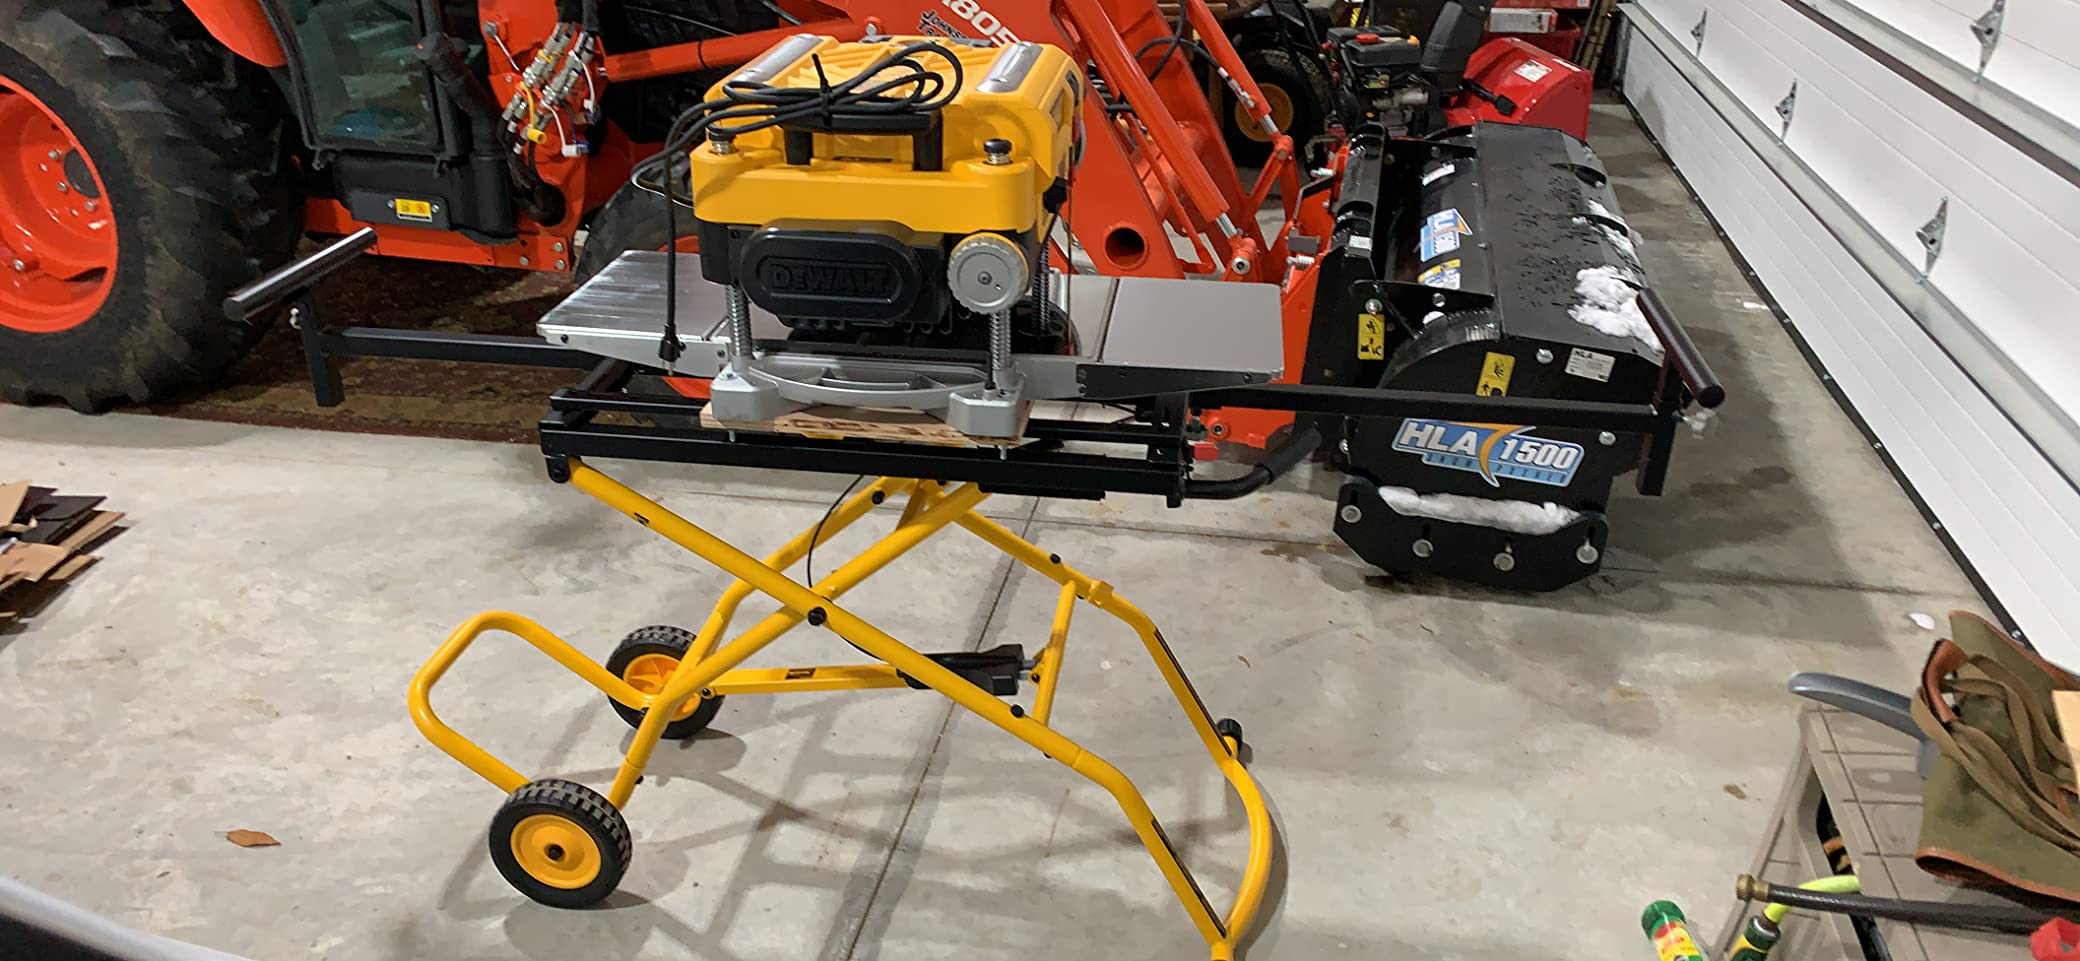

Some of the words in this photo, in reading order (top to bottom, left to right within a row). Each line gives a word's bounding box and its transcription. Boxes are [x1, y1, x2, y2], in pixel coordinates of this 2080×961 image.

[942, 0, 1020, 46] 805
[1399, 421, 1479, 456] HLA
[1499, 438, 1579, 470] 1500
